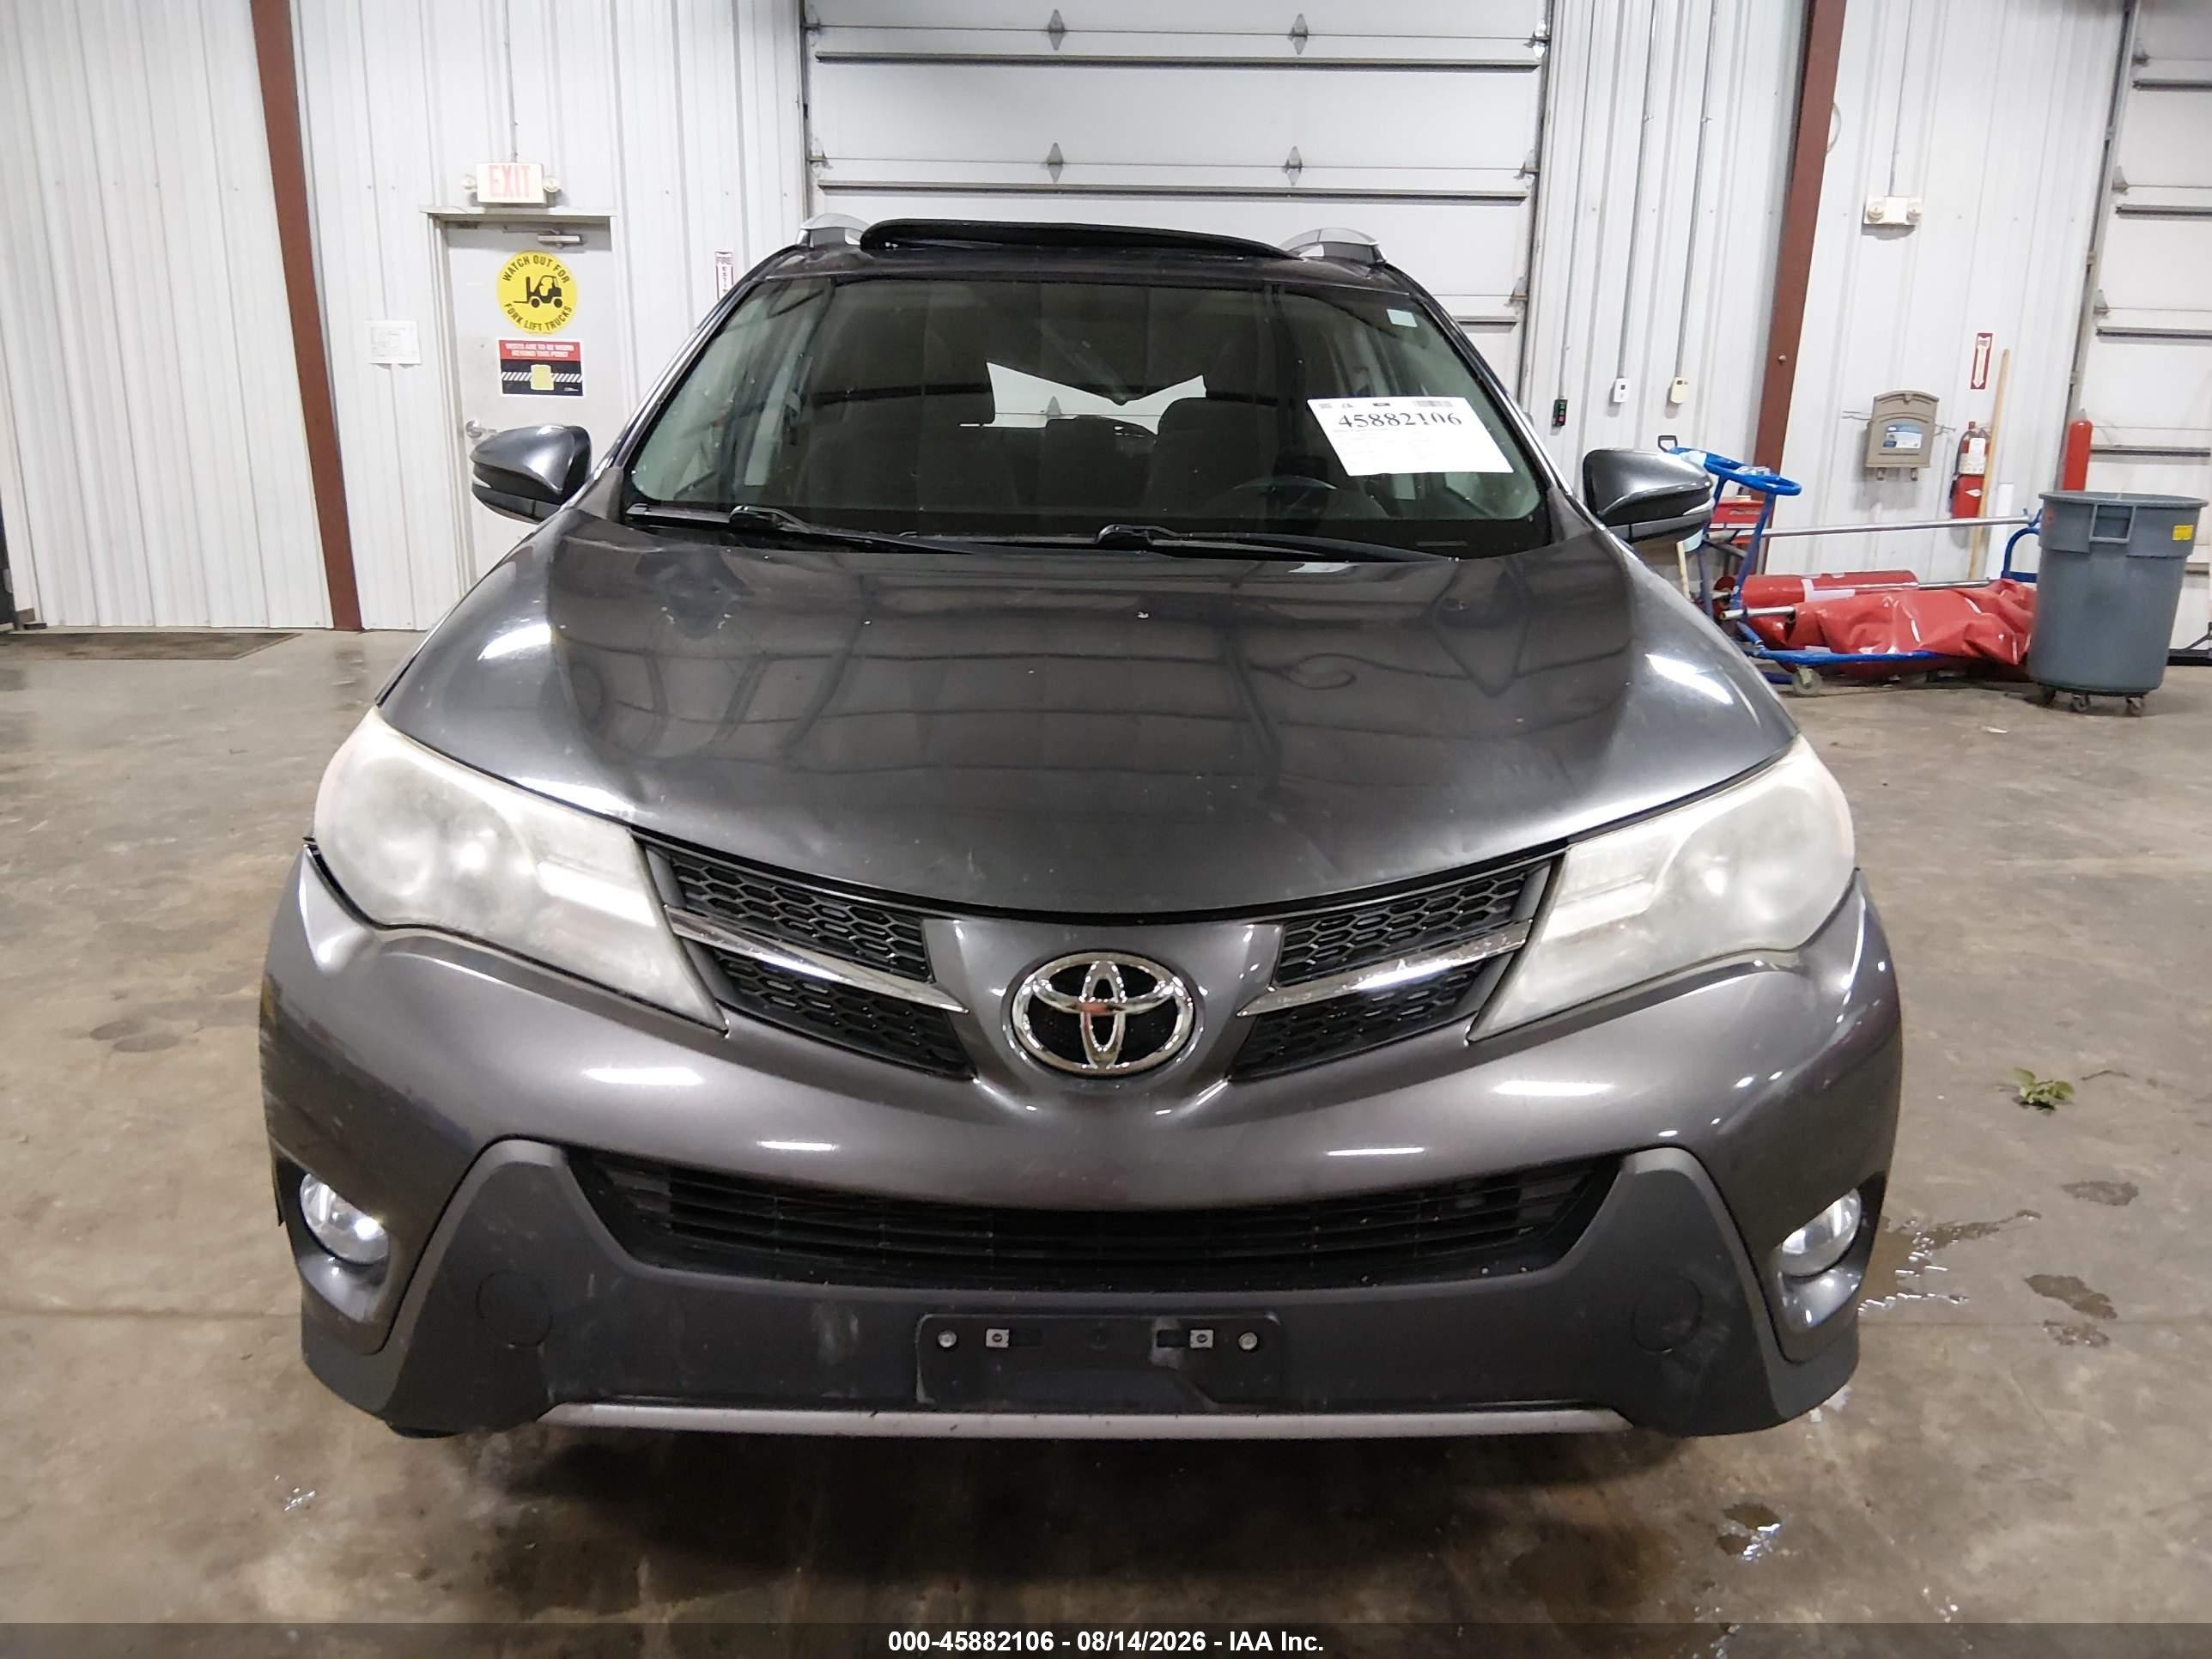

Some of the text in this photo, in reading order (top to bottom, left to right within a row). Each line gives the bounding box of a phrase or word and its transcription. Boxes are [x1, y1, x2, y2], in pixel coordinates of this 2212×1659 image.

[489, 164, 531, 198] EXIT
[502, 254, 571, 283] WATCH OUT FOR
[504, 303, 573, 331] FORK LIFT TRUCKS
[1339, 412, 1462, 428] 45882106
